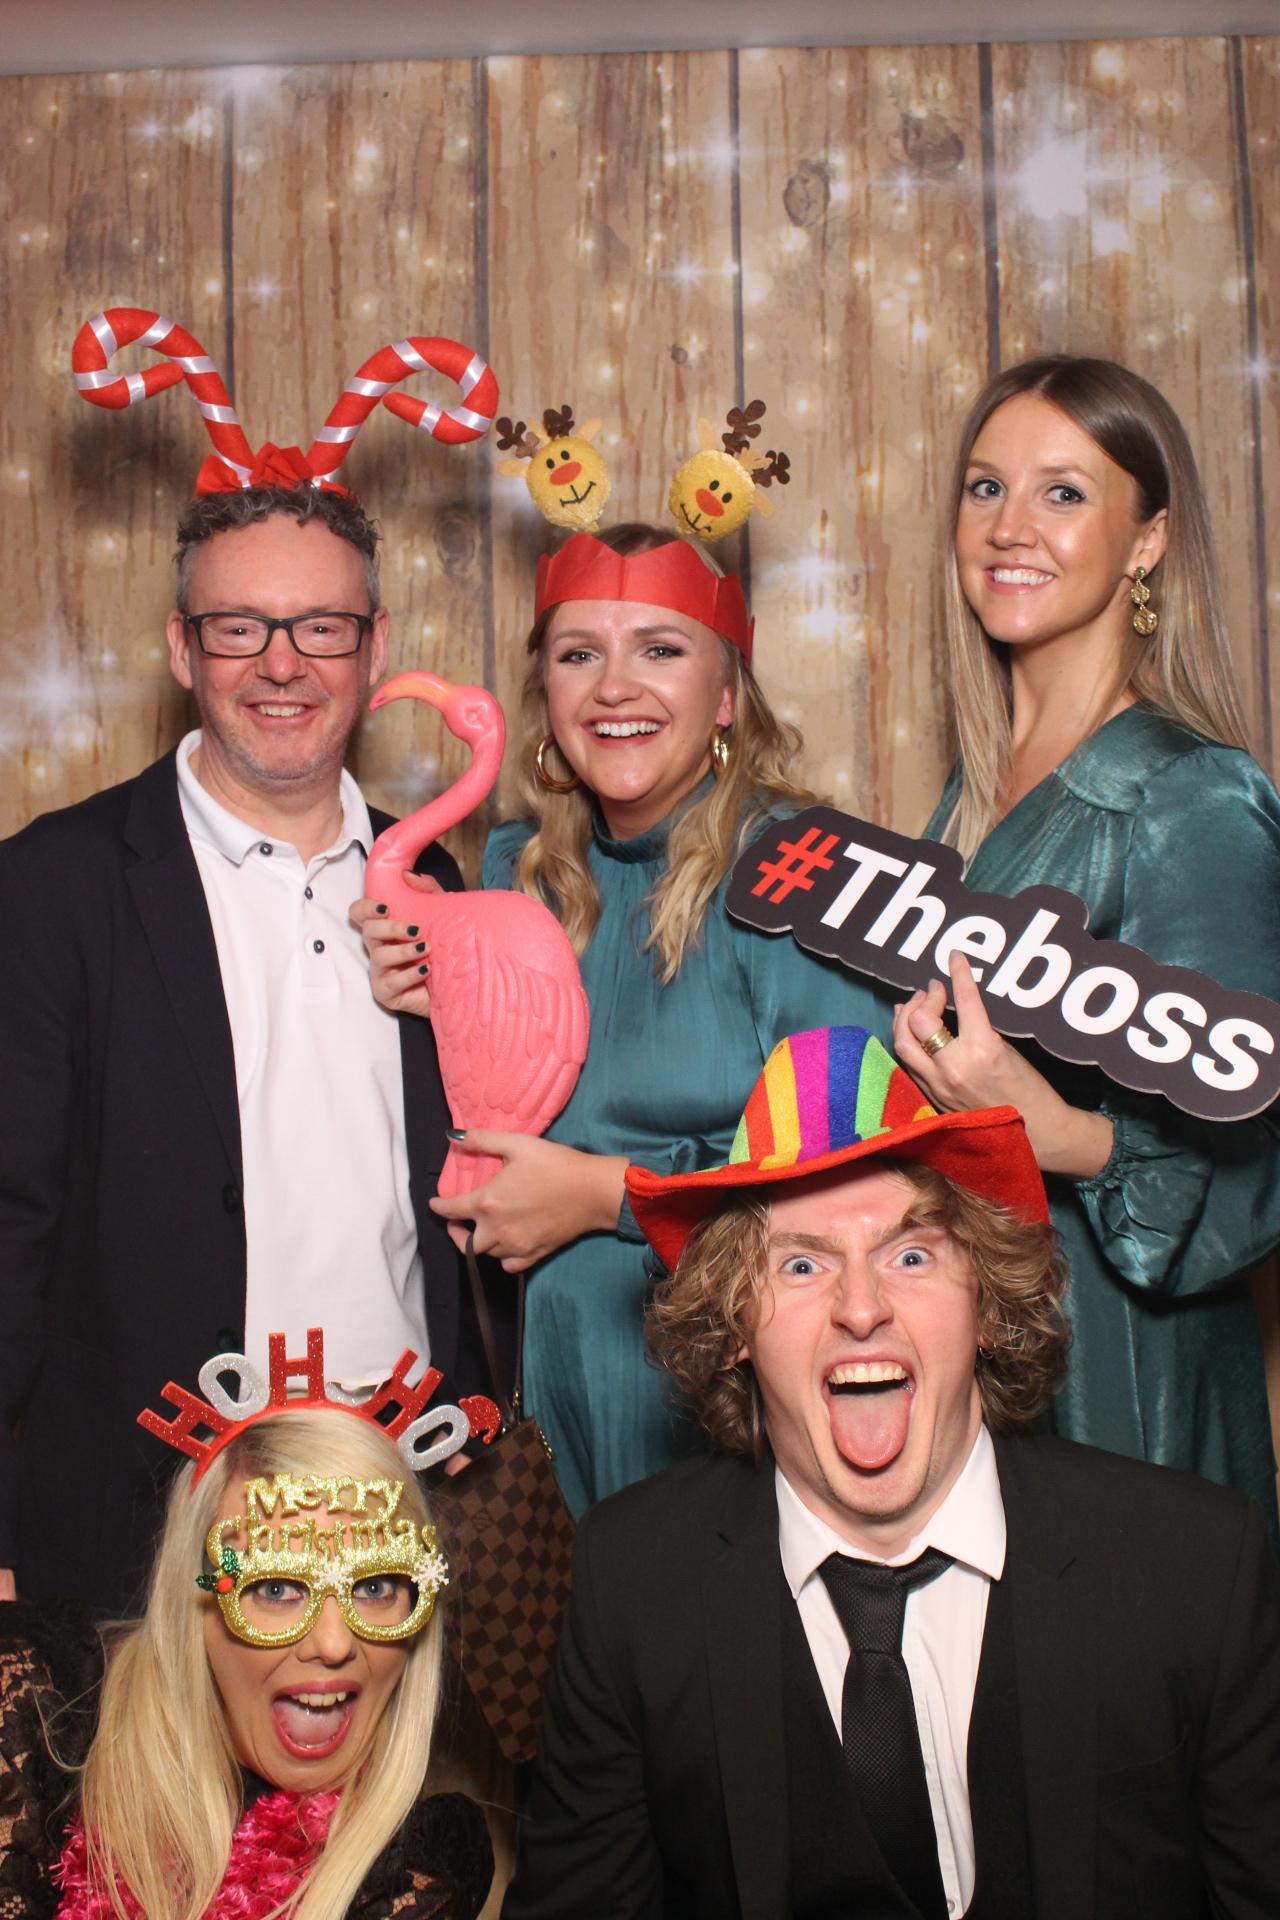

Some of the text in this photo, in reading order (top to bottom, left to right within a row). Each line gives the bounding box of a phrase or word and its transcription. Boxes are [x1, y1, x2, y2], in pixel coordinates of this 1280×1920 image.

[750, 826, 1275, 1092] #Theboss
[245, 1471, 404, 1521] Merry
[206, 1513, 437, 1566] Christmas
